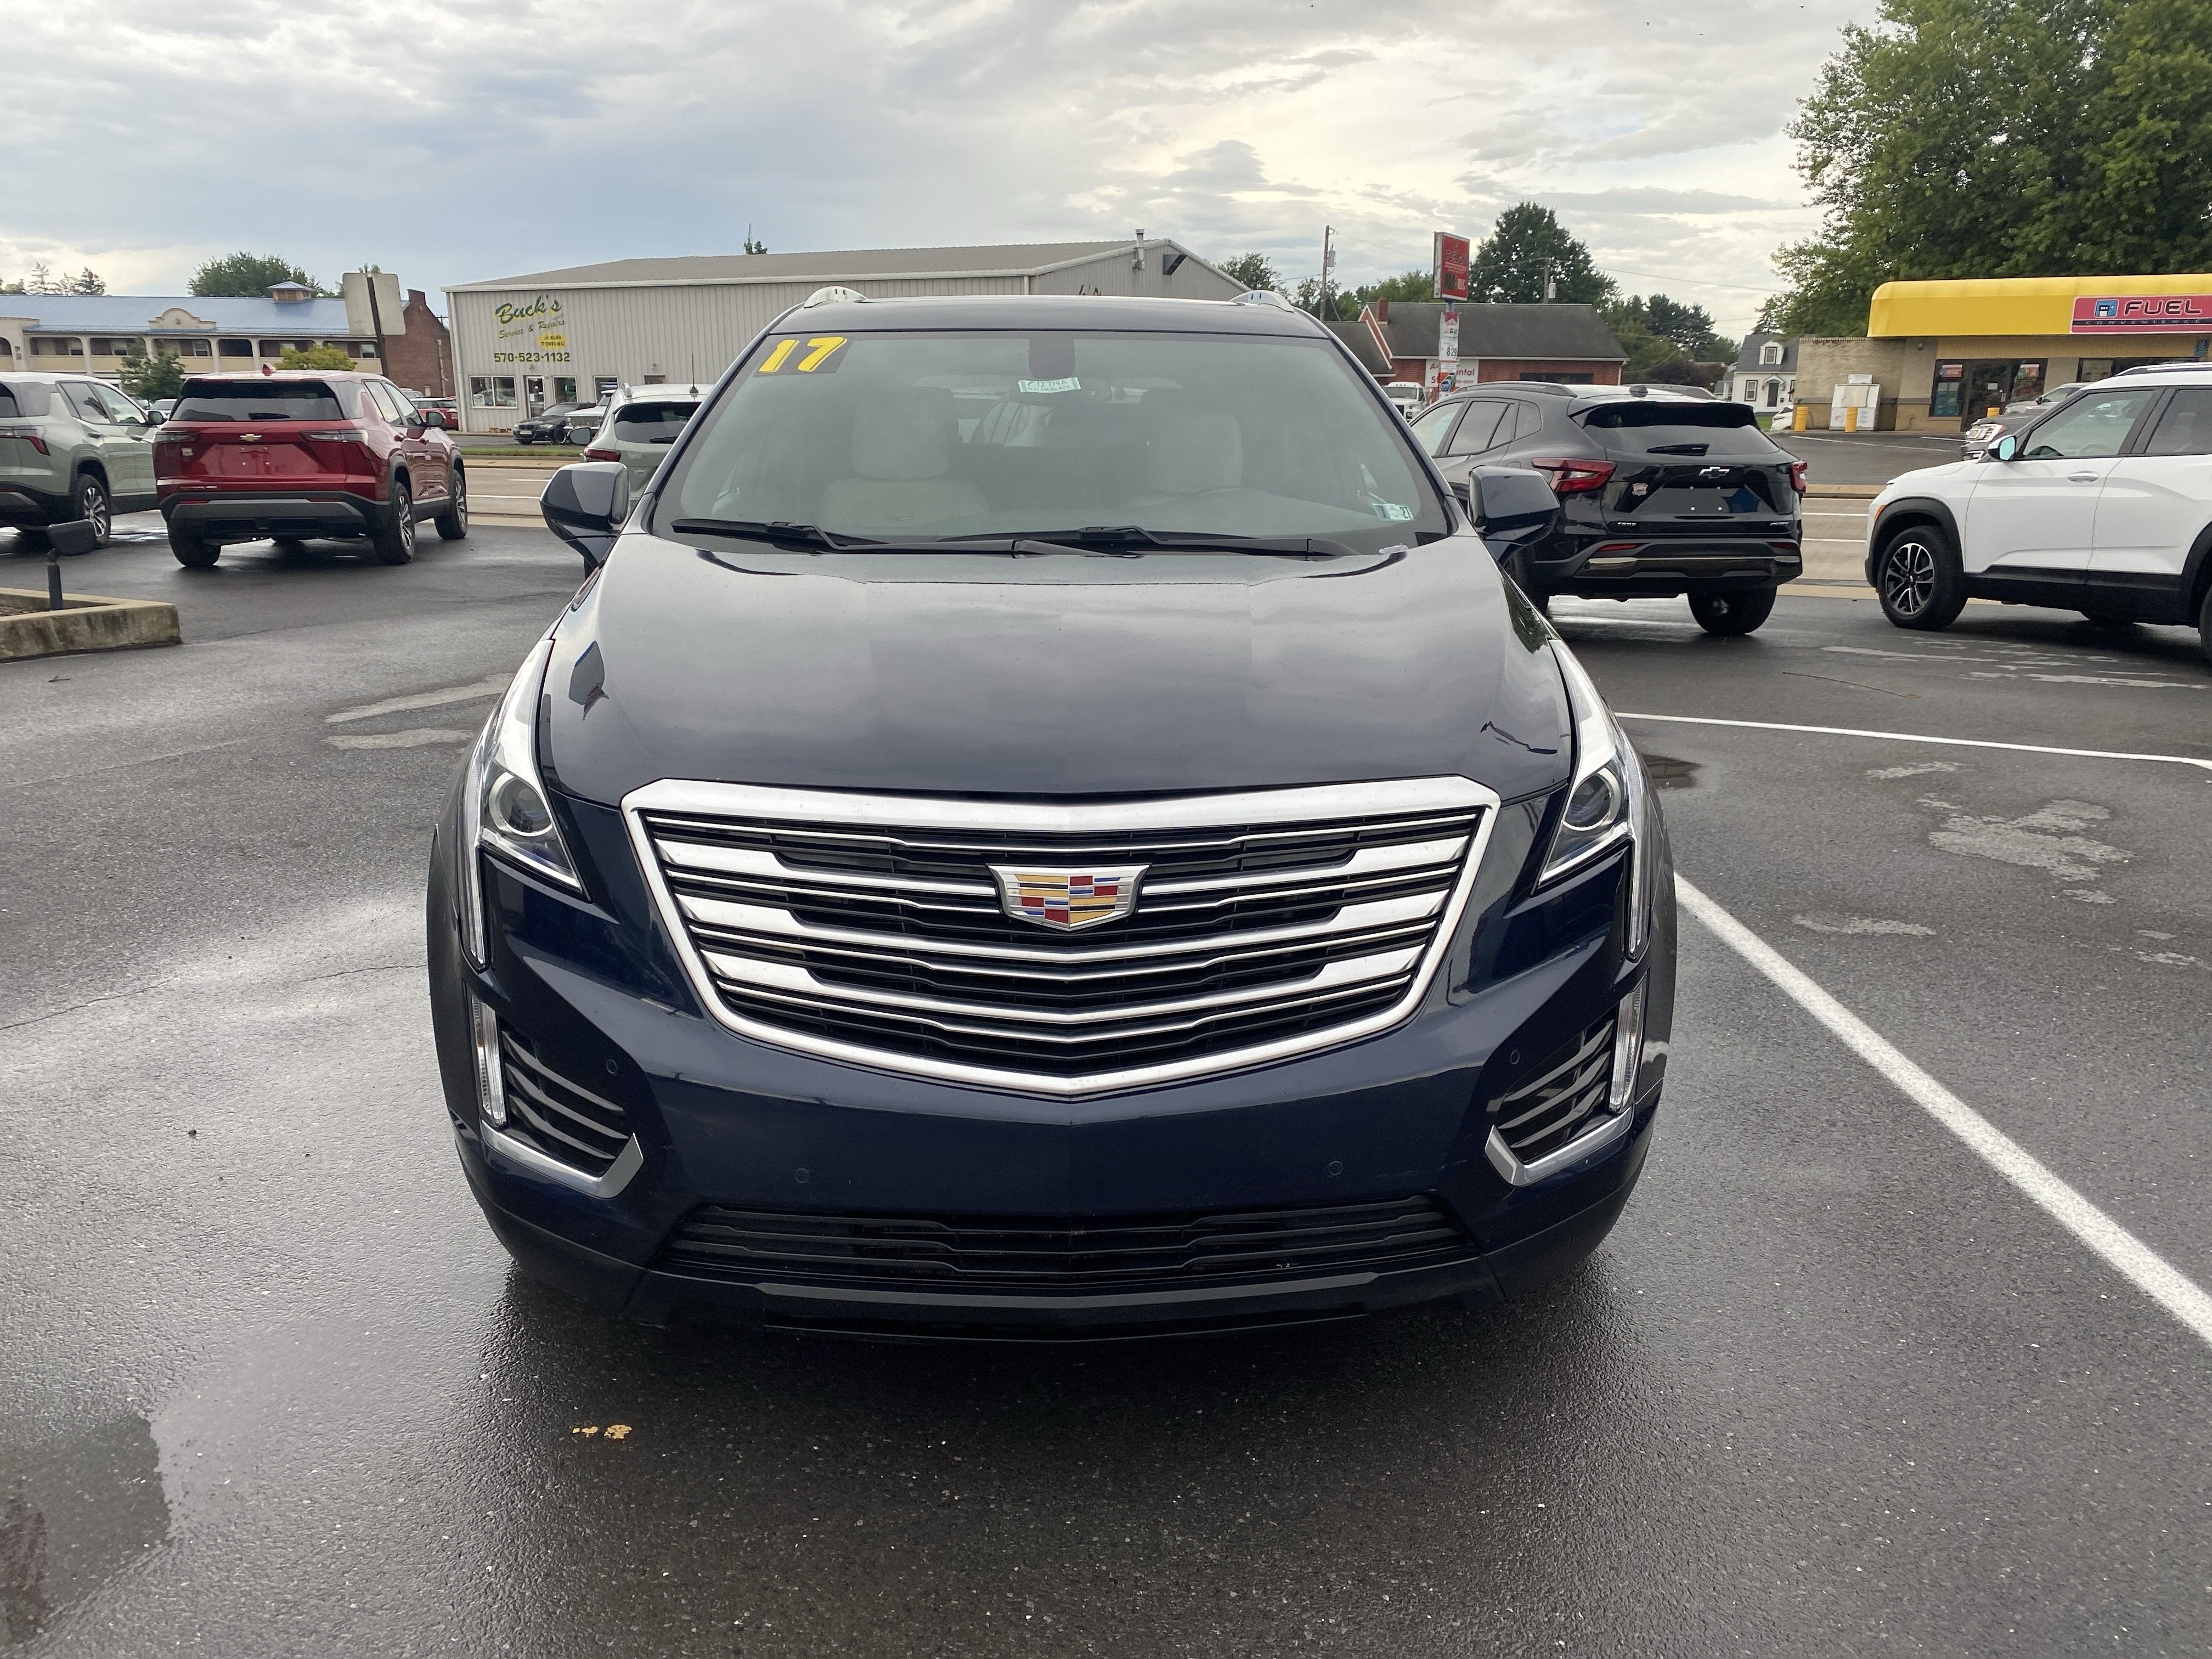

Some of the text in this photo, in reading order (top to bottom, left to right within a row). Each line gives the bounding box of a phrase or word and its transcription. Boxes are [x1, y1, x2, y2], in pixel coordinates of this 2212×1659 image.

[495, 294, 563, 324] Buck's
[2124, 299, 2202, 315] FUEL
[494, 352, 571, 362] 570-523-1132
[759, 336, 848, 373] 17
